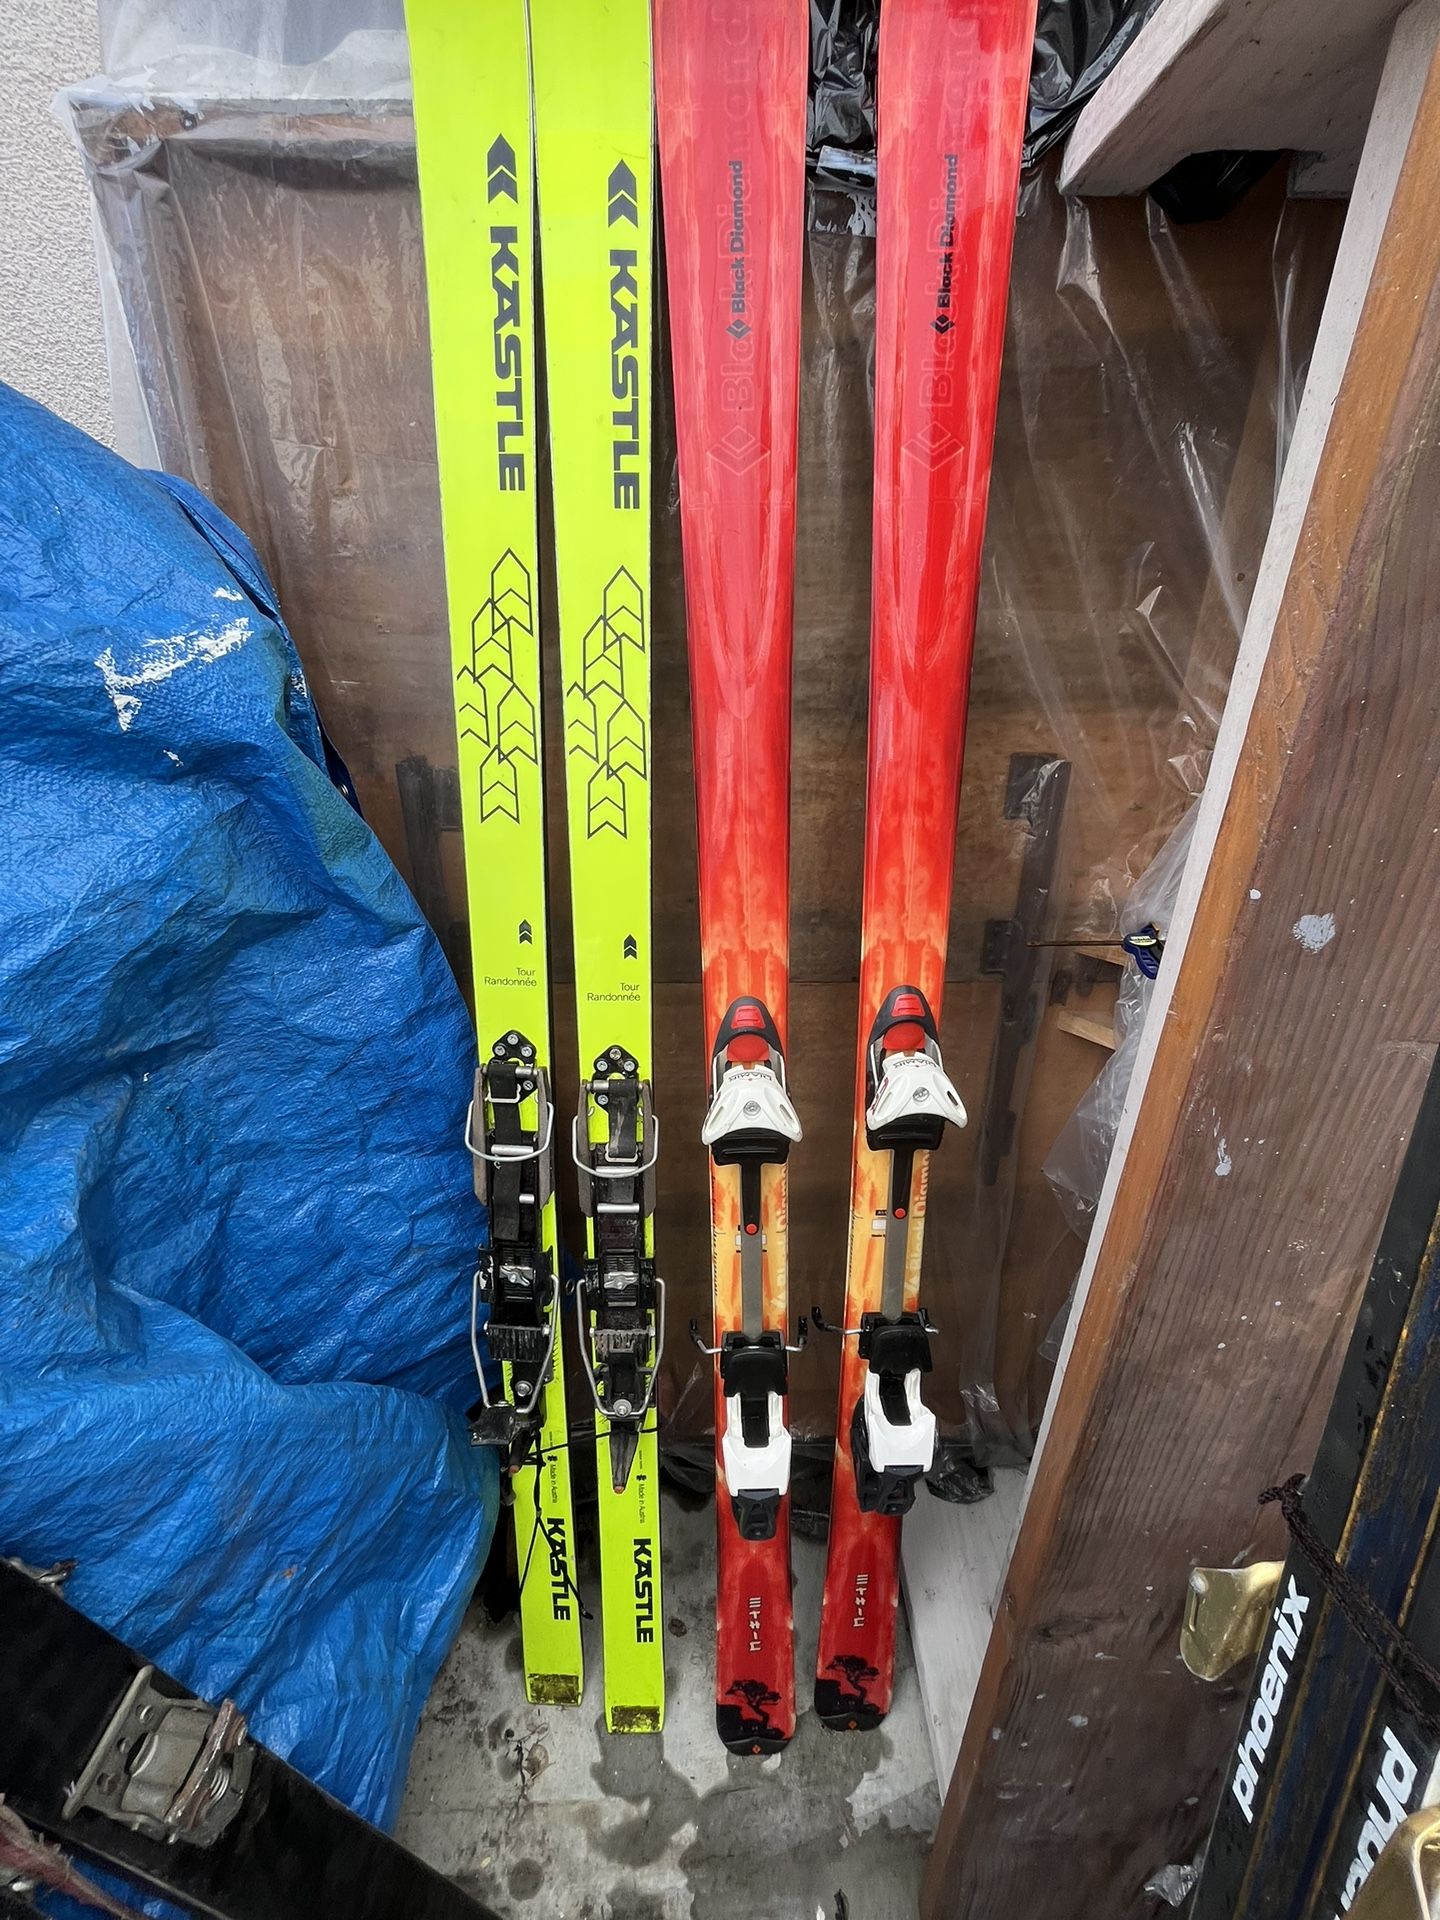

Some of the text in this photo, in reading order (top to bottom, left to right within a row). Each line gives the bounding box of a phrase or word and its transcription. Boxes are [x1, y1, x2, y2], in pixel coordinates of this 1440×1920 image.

[729, 160, 746, 313] Black Diamond
[937, 154, 958, 308] Black Diamond
[490, 226, 525, 491] KASTLE
[609, 249, 640, 509] KASTLE
[484, 976, 537, 987] Randonnée
[516, 967, 536, 977] Tour
[587, 992, 641, 1002] Randonnée
[620, 983, 640, 992] Tour
[549, 1464, 558, 1480] Made
[638, 1484, 646, 1500] Made
[633, 1538, 654, 1643] KASTLE
[1232, 1574, 1310, 1824] phoenix
